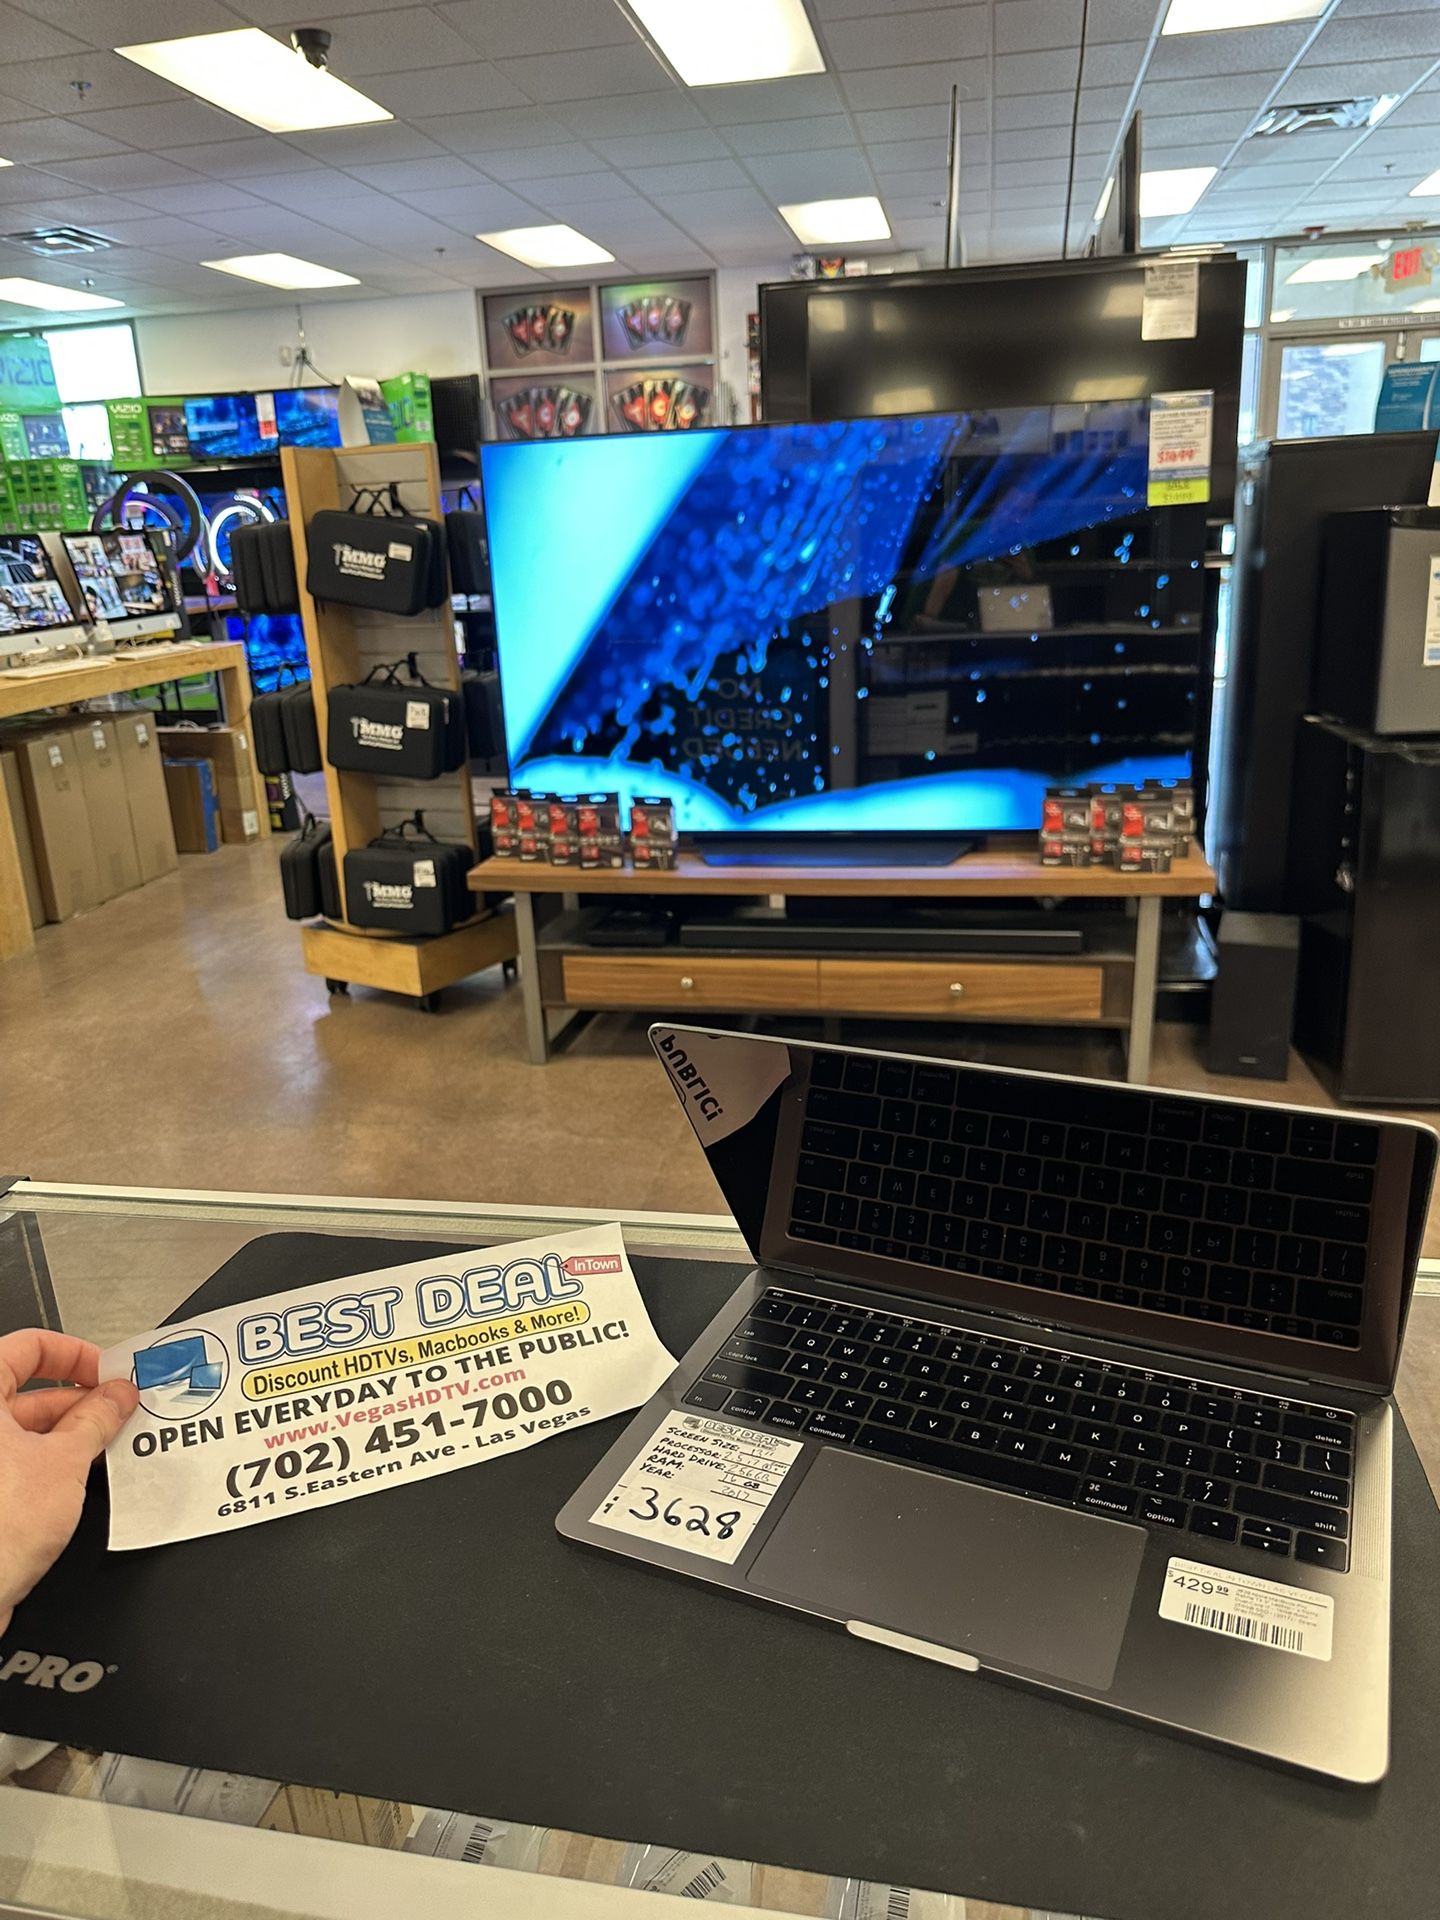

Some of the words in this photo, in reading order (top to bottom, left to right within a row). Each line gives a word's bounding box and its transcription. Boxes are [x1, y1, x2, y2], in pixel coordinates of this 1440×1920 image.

[109, 404, 142, 414] VIZIO
[573, 1257, 620, 1273] InTown
[1393, 1247, 1423, 1280] EXIT
[237, 1286, 403, 1365] BEST
[415, 1253, 584, 1328] DEAL
[807, 1339, 816, 1347] Q
[253, 1359, 340, 1395] Discount
[344, 1347, 414, 1376] HDTVs,
[417, 1326, 510, 1360] Macbooks
[515, 1319, 529, 1334] &
[530, 1305, 581, 1330] More!
[843, 1347, 855, 1355] W
[921, 1365, 930, 1373] R
[132, 1415, 225, 1457] OPEN
[234, 1375, 398, 1435] EVERYDAY
[406, 1364, 448, 1388] TO
[454, 1346, 513, 1375] THE
[518, 1319, 630, 1360] PUBLIC!
[878, 1381, 888, 1389] D
[1074, 1380, 1082, 1388] 8
[805, 1390, 815, 1398] Z
[1045, 1394, 1055, 1402] U
[1118, 1389, 1126, 1397] 9
[845, 1400, 855, 1408] X
[961, 1401, 970, 1409] G
[1161, 1399, 1170, 1407] 0
[264, 1368, 527, 1449] www.VegasHDTV.com
[730, 1405, 757, 1416] control
[886, 1410, 895, 1418] C
[1003, 1411, 1013, 1419] H
[1133, 1414, 1143, 1422] O
[772, 1416, 796, 1426] option
[929, 1420, 938, 1428] V
[1048, 1422, 1056, 1430] J
[704, 1420, 741, 1436] BEST
[741, 1429, 779, 1447] DEAL
[809, 1425, 846, 1440] command
[971, 1431, 980, 1439] B
[1091, 1432, 1100, 1440] K
[226, 1436, 351, 1498] (702)
[365, 1381, 573, 1455] 451-7000
[666, 1427, 708, 1443] SCREEN
[711, 1439, 740, 1453] SIZE:
[1314, 1434, 1342, 1446] delete
[660, 1437, 722, 1459] PROCESSOR:
[1014, 1442, 1025, 1451] N
[1138, 1442, 1145, 1451] L
[217, 1492, 276, 1517] 6811
[284, 1459, 402, 1501] S.Eastern
[410, 1444, 455, 1467] Ave
[476, 1428, 516, 1449] Las
[520, 1406, 592, 1434] Vegas
[652, 1445, 686, 1459] HARD
[688, 1454, 727, 1472] DRIVE:
[1059, 1452, 1071, 1462] M
[647, 1455, 685, 1470] RAM:
[639, 1463, 675, 1479] YEAR:
[1309, 1489, 1339, 1501] return
[1085, 1496, 1128, 1512] command
[628, 1486, 741, 1540] 3628
[1146, 1512, 1176, 1524] option
[1314, 1520, 1336, 1532] shift
